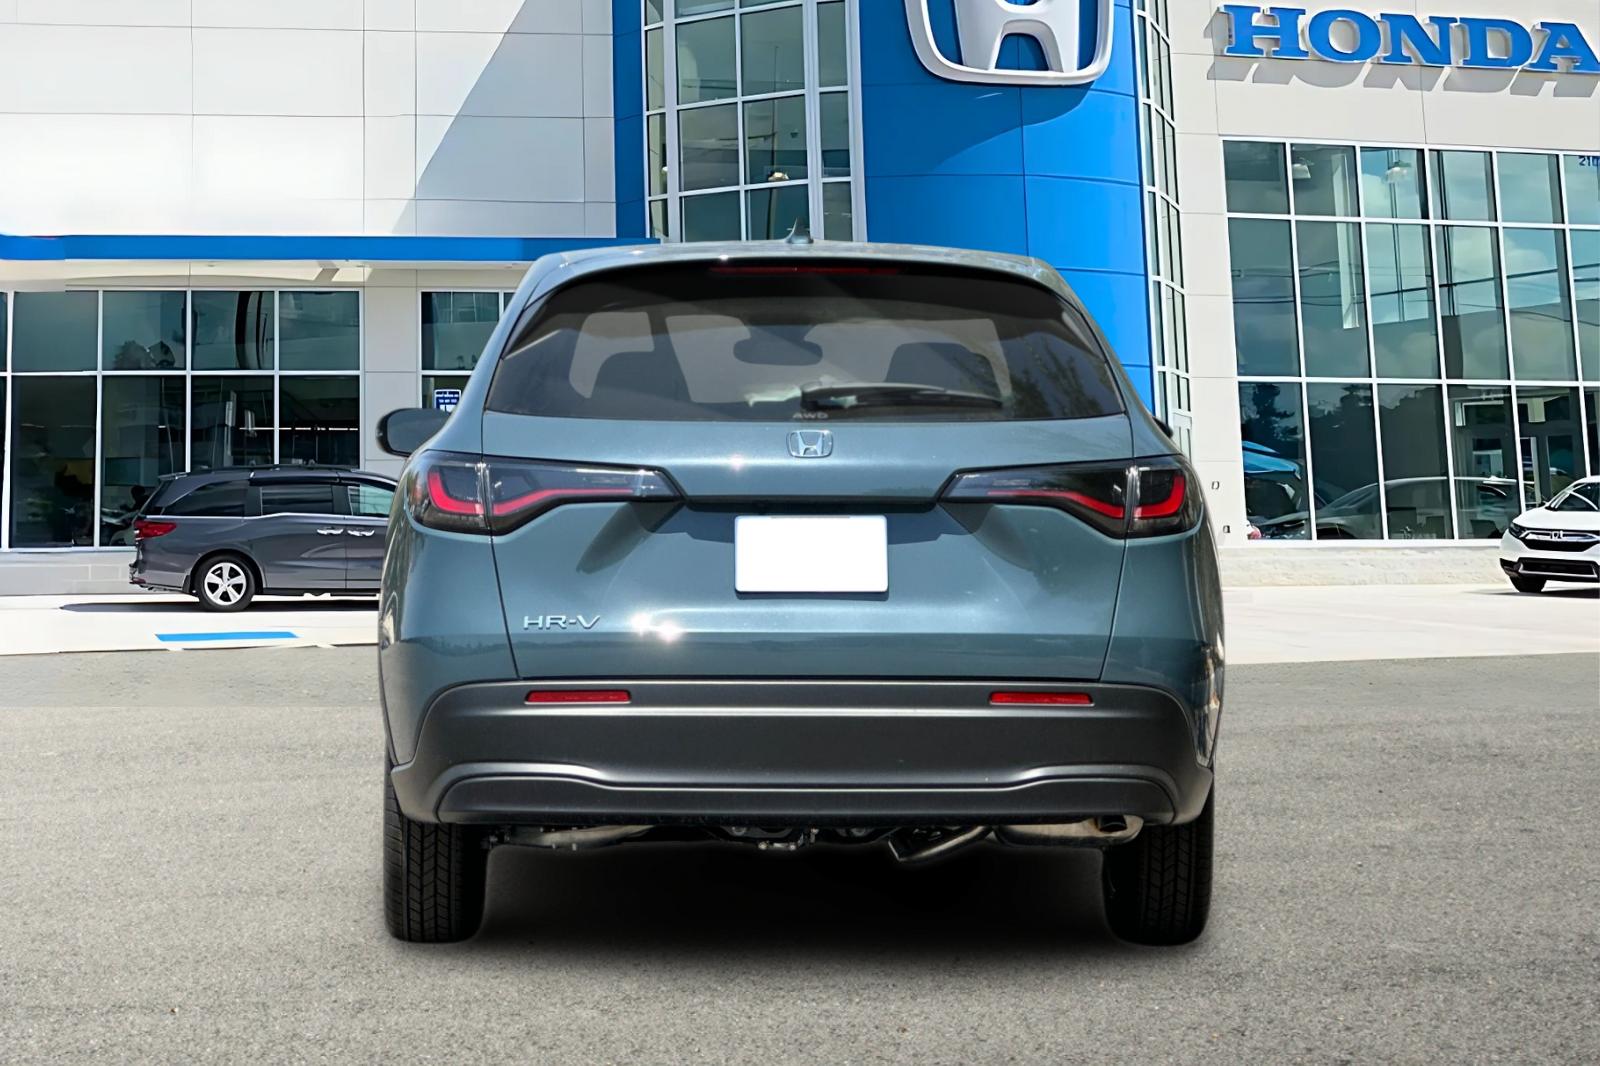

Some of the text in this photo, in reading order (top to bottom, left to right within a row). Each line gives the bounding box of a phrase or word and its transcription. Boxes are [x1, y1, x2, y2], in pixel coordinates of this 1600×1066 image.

[1222, 4, 1600, 73] HONDA
[793, 411, 829, 419] AWD
[523, 614, 601, 630] HR-V
